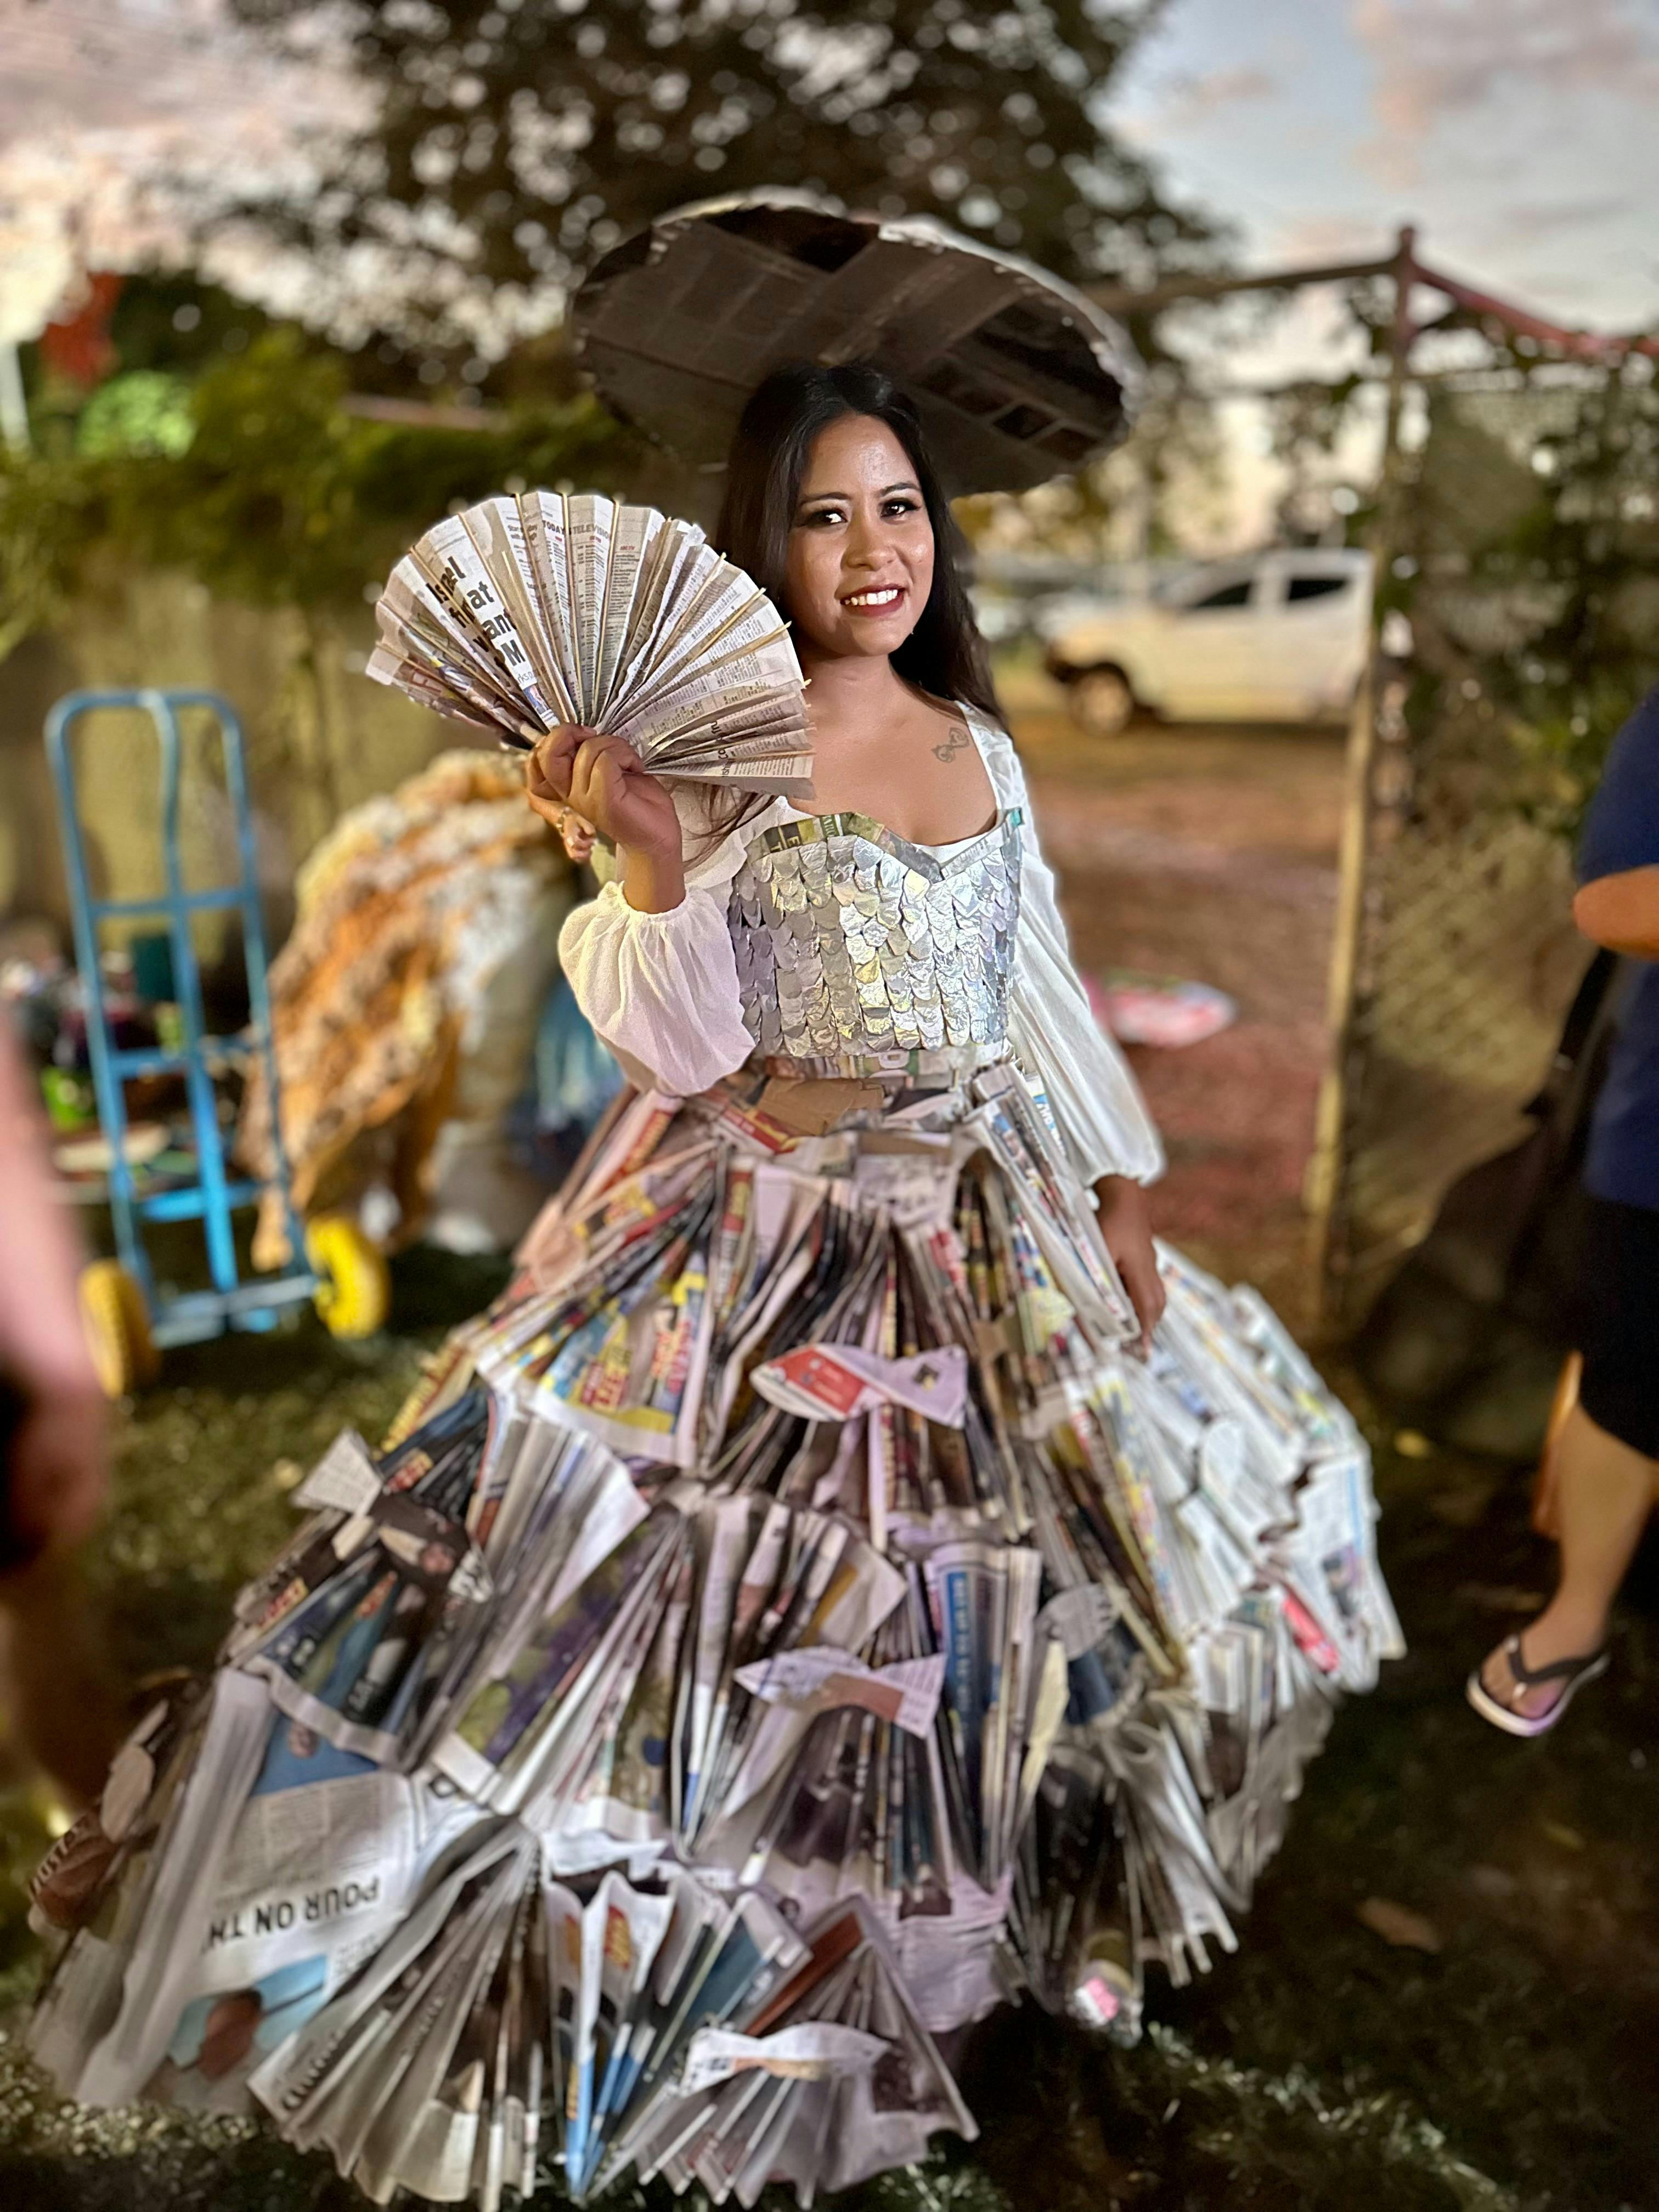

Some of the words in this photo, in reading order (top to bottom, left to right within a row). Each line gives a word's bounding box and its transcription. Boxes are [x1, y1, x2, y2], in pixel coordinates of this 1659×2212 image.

[573, 523, 611, 540] TELEVISIO
[467, 581, 494, 609] at
[304, 1876, 380, 1921] POUR
[255, 1901, 294, 1934] ON
